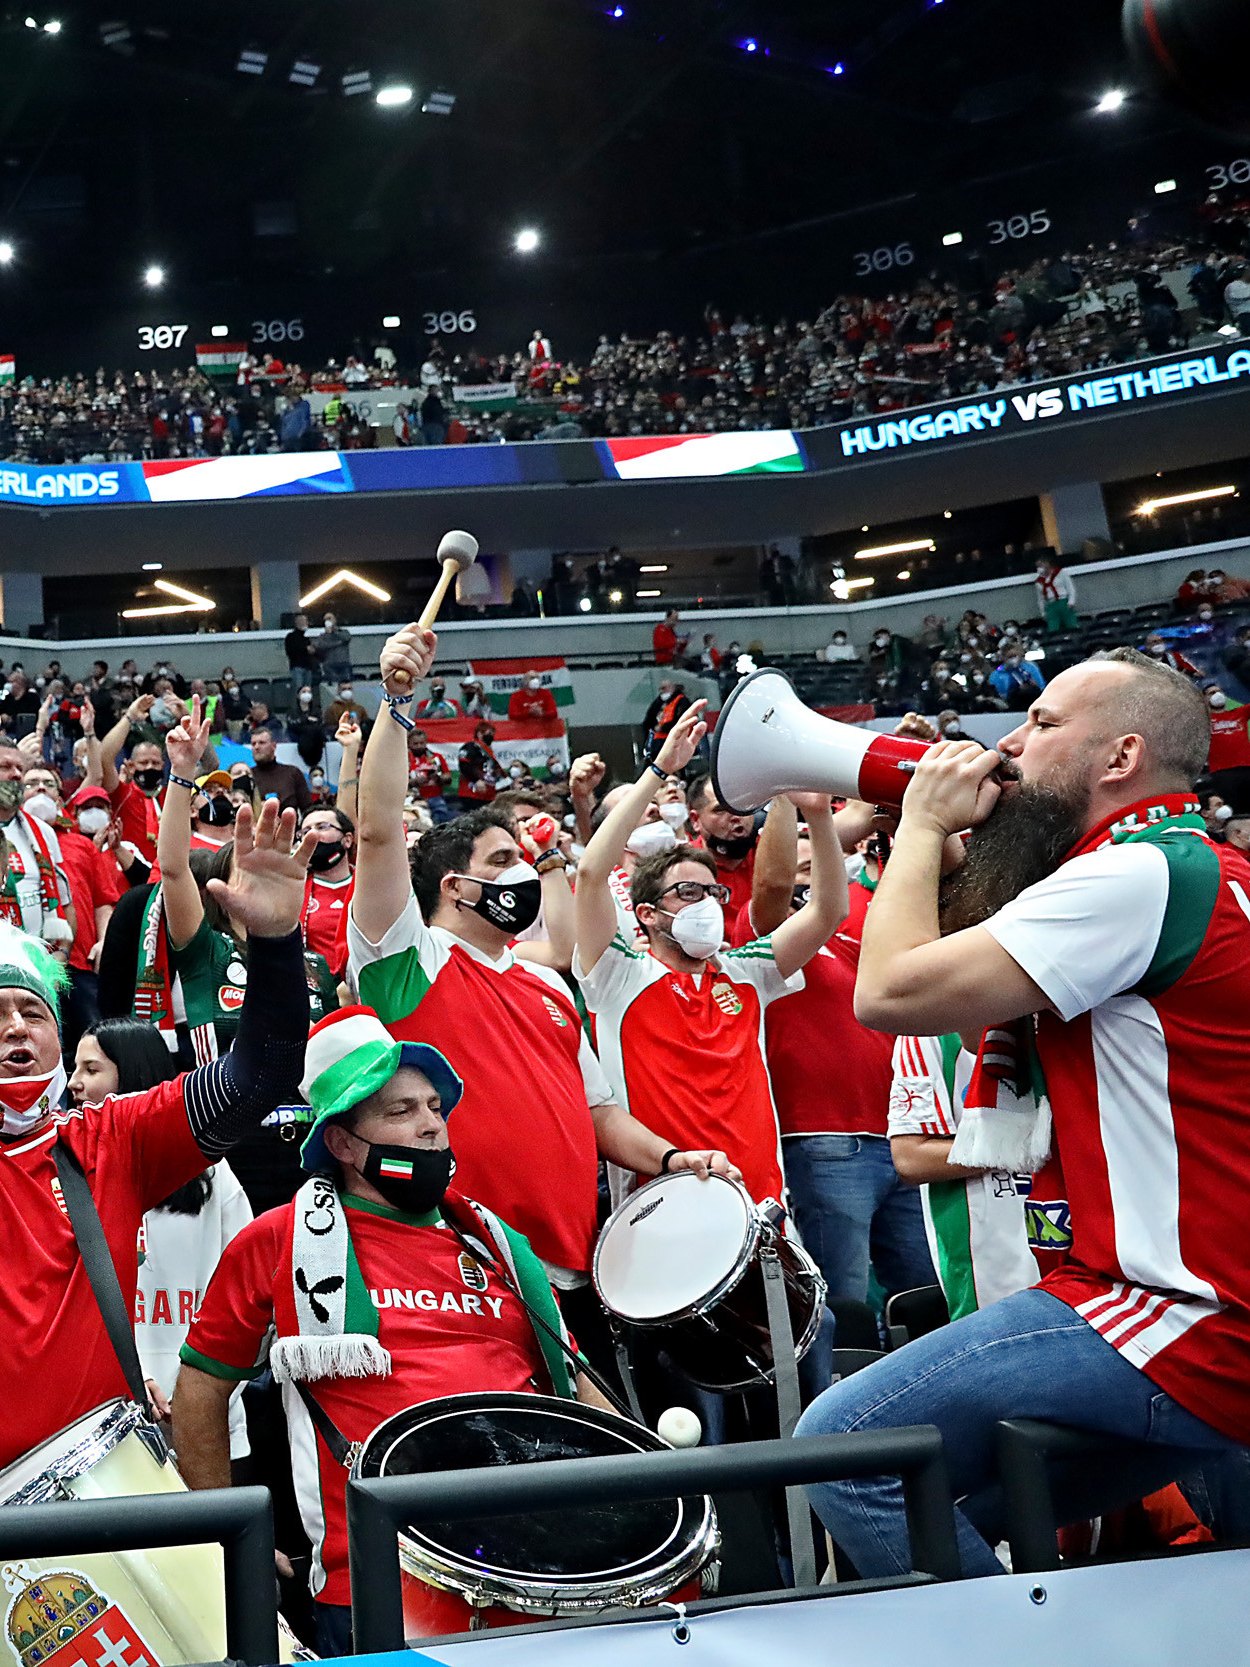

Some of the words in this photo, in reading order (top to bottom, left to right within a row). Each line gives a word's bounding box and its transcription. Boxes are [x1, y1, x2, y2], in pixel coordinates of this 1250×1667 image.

[986, 209, 1051, 244] 305
[853, 242, 915, 276] 306
[137, 324, 189, 350] 307
[251, 319, 305, 344] 306
[423, 309, 478, 335] 306
[840, 399, 1006, 456] HUNGARY
[1012, 388, 1063, 422] VS
[1067, 350, 1250, 411] NETHERLA
[370, 1287, 503, 1319] UNGARY
